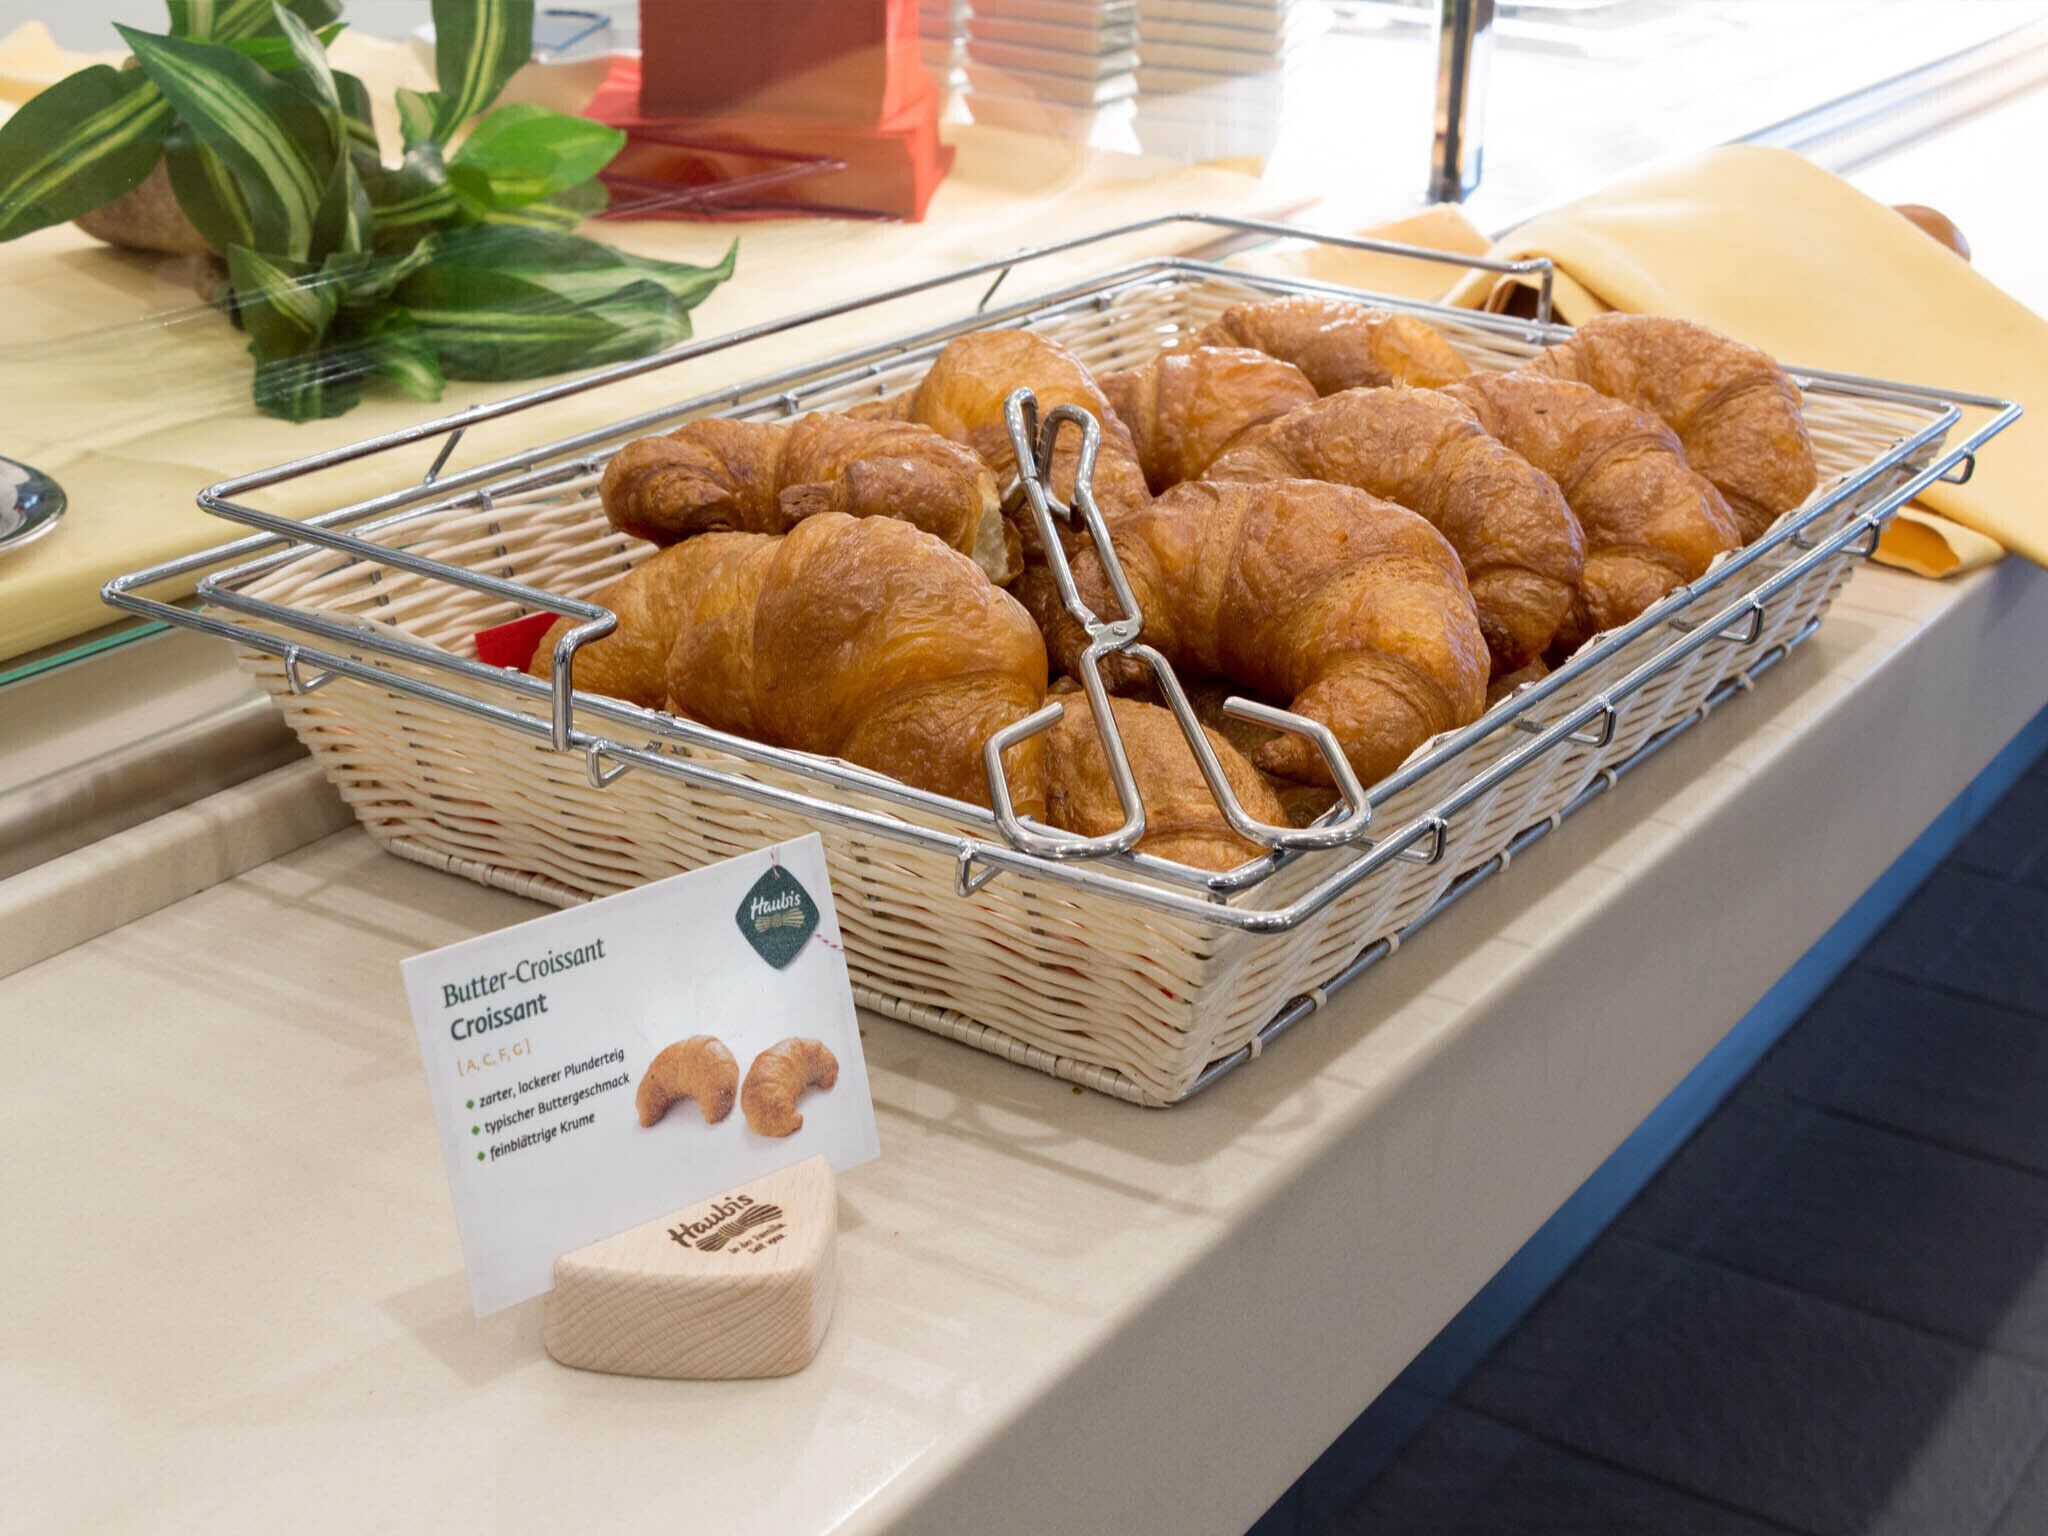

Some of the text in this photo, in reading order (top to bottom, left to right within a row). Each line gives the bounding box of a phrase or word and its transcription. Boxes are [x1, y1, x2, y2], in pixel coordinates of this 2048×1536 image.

[751, 891, 801, 921] Haubis
[442, 938, 606, 1008] Butter-Croissant
[451, 993, 548, 1041] Croissant
[480, 1048, 625, 1108] zarter, lockerer Plunderteig
[484, 1072, 631, 1135] typischer Buttergeschmack
[490, 1113, 595, 1162] feinblättrige Krume
[667, 1195, 755, 1248] Haubis
